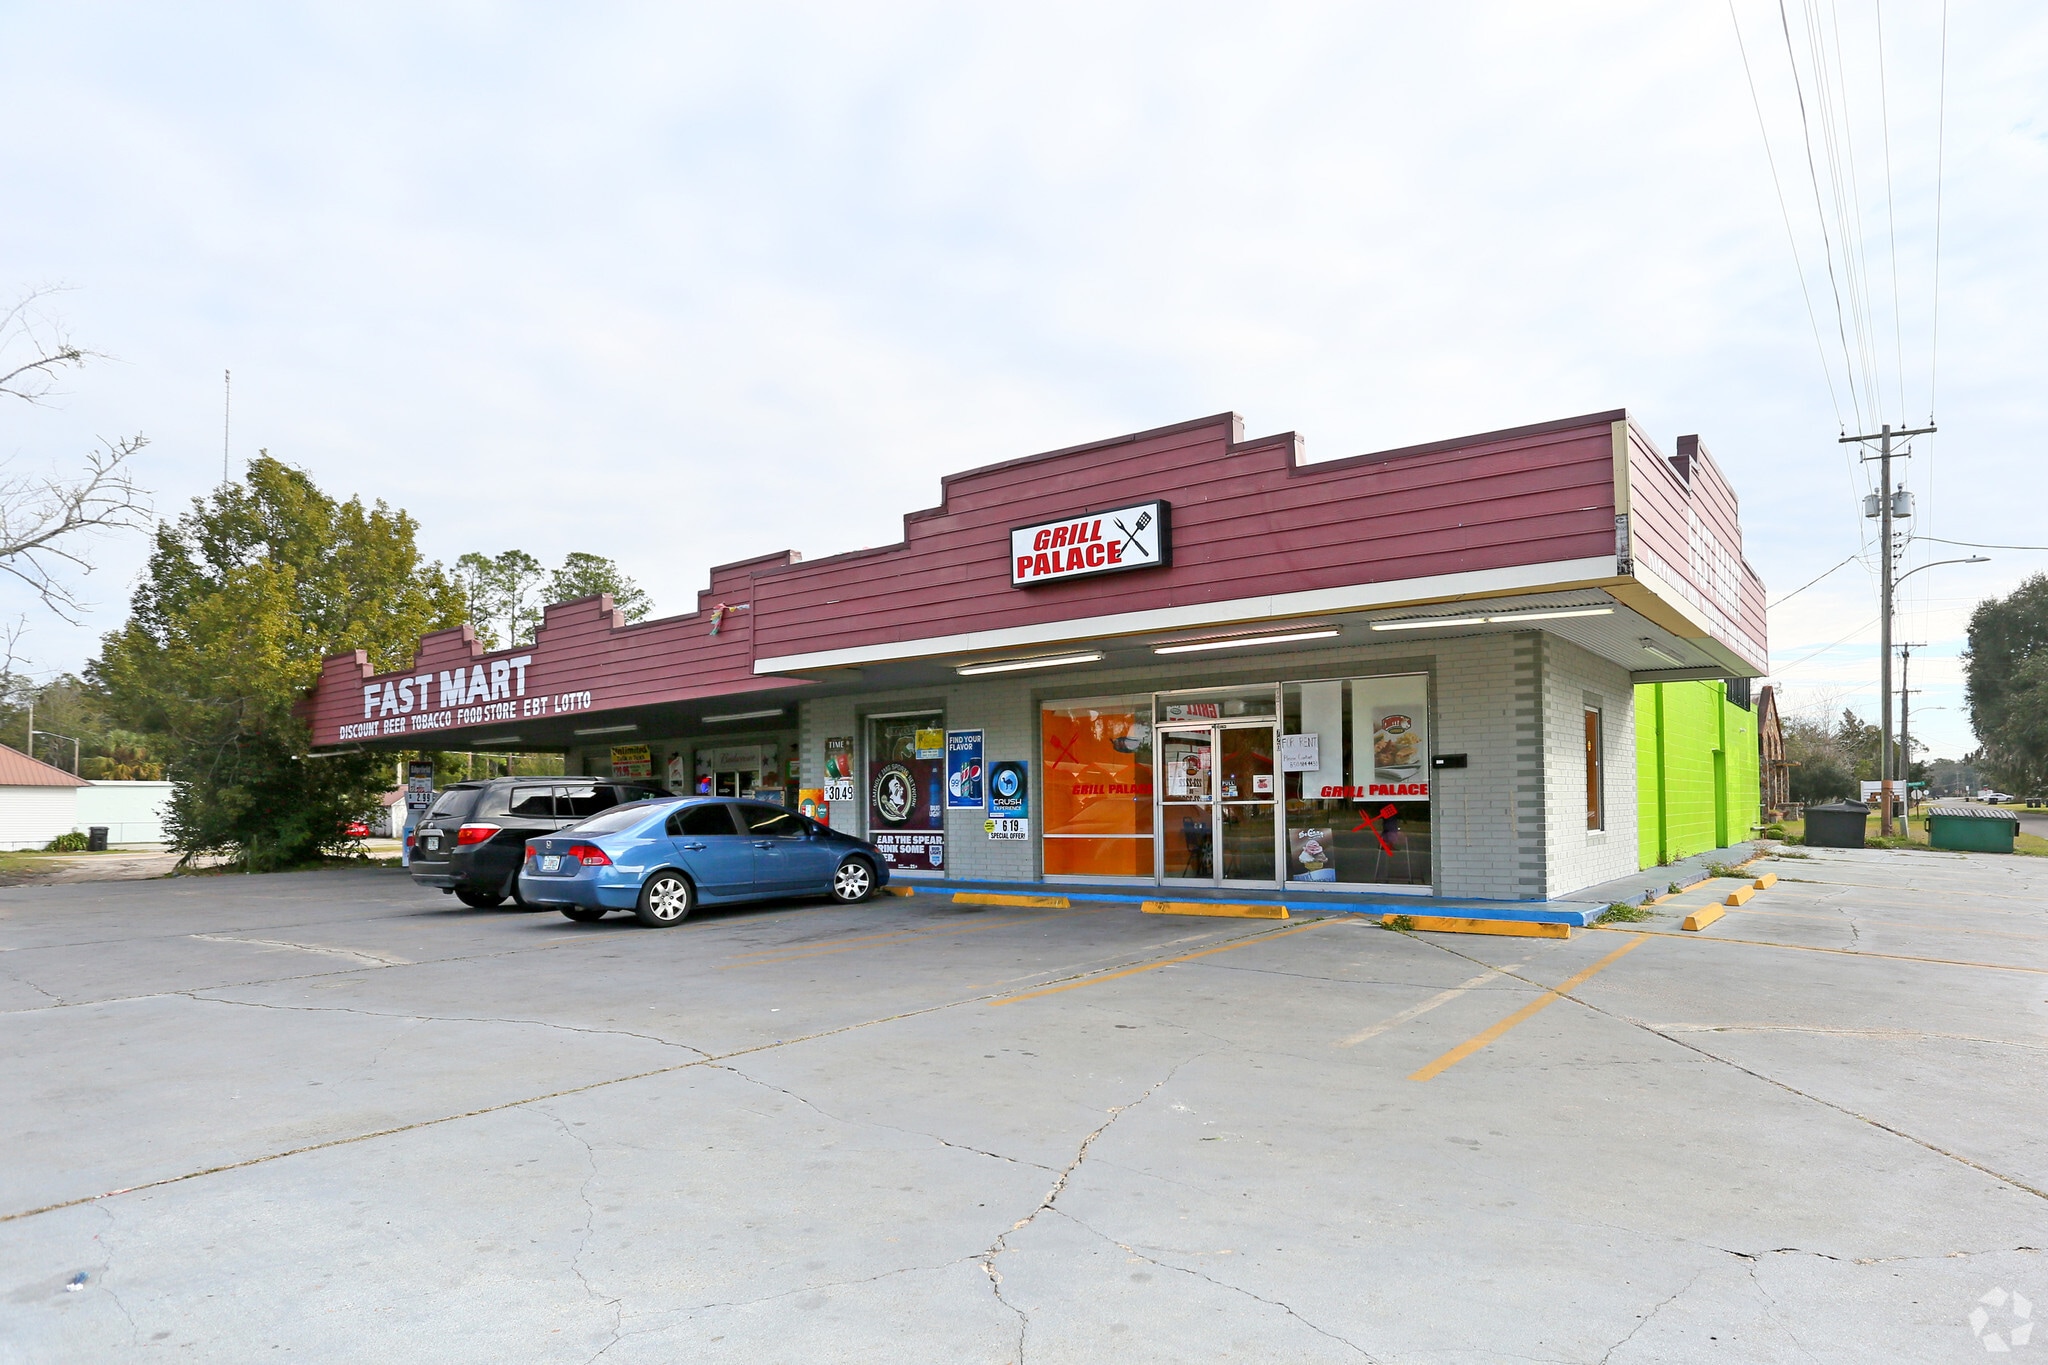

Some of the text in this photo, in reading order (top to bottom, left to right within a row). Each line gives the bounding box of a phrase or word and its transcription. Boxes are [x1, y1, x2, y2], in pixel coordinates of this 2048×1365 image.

[1033, 519, 1102, 552] GRILL
[1017, 540, 1122, 579] PALACE
[364, 655, 532, 719] FAST MART
[340, 721, 379, 739] DISCOUNT
[384, 717, 406, 734] BEER
[411, 710, 452, 730] TOBACCO
[523, 697, 548, 717] EBT
[554, 691, 591, 713] LOTTO
[829, 741, 844, 749] TIME
[949, 736, 964, 744] FIND
[964, 735, 982, 743] YOUR
[1282, 737, 1294, 748] FOR
[1299, 737, 1317, 748] RENT
[949, 743, 973, 751] FLAVOR
[829, 786, 853, 800] 30.49
[872, 772, 882, 806] SEMINOLE
[907, 775, 917, 808] NETWORK
[1072, 784, 1154, 795] GRILL PALACE
[1320, 784, 1428, 798] GRILL PALACE
[993, 798, 1022, 806] CRUSH
[895, 835, 912, 844] THE
[912, 835, 945, 845] SPEAR.
[990, 832, 1026, 840] SPECIAL OFFER!
[899, 844, 925, 854] SOME
